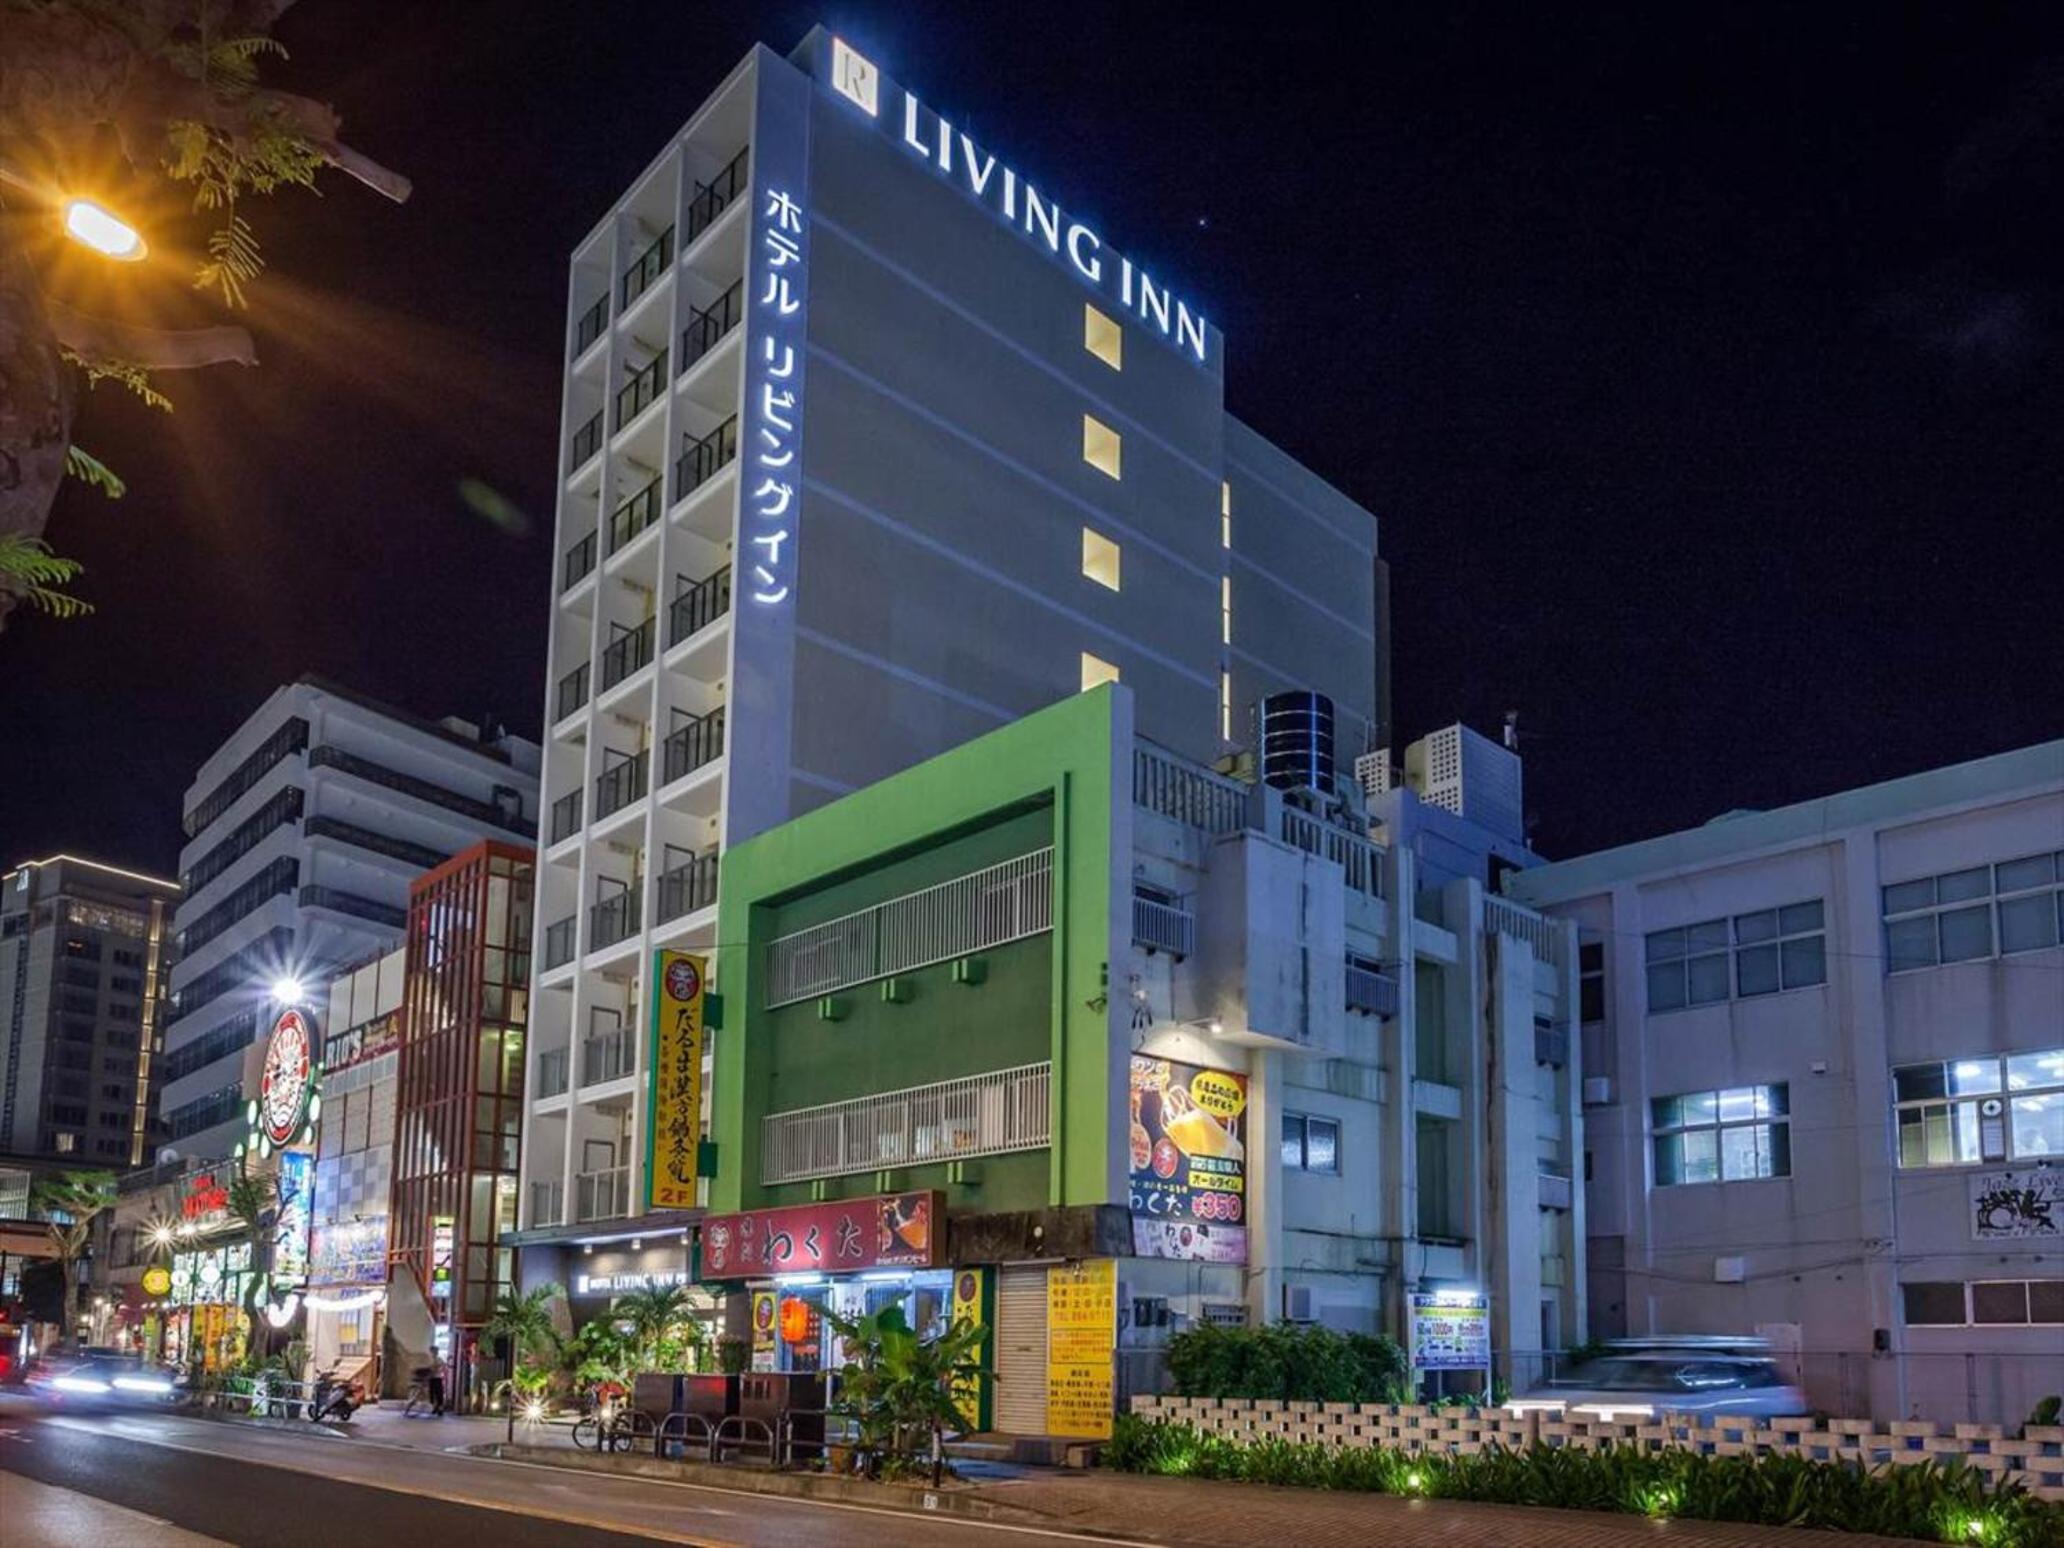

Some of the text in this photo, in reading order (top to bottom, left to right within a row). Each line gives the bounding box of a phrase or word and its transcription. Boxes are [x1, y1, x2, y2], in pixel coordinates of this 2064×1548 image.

[904, 91, 1206, 361] LIVING INN
[753, 189, 802, 604] ホテル リビングイン
[660, 1187, 688, 1204] 2F
[761, 1214, 864, 1266] わくた
